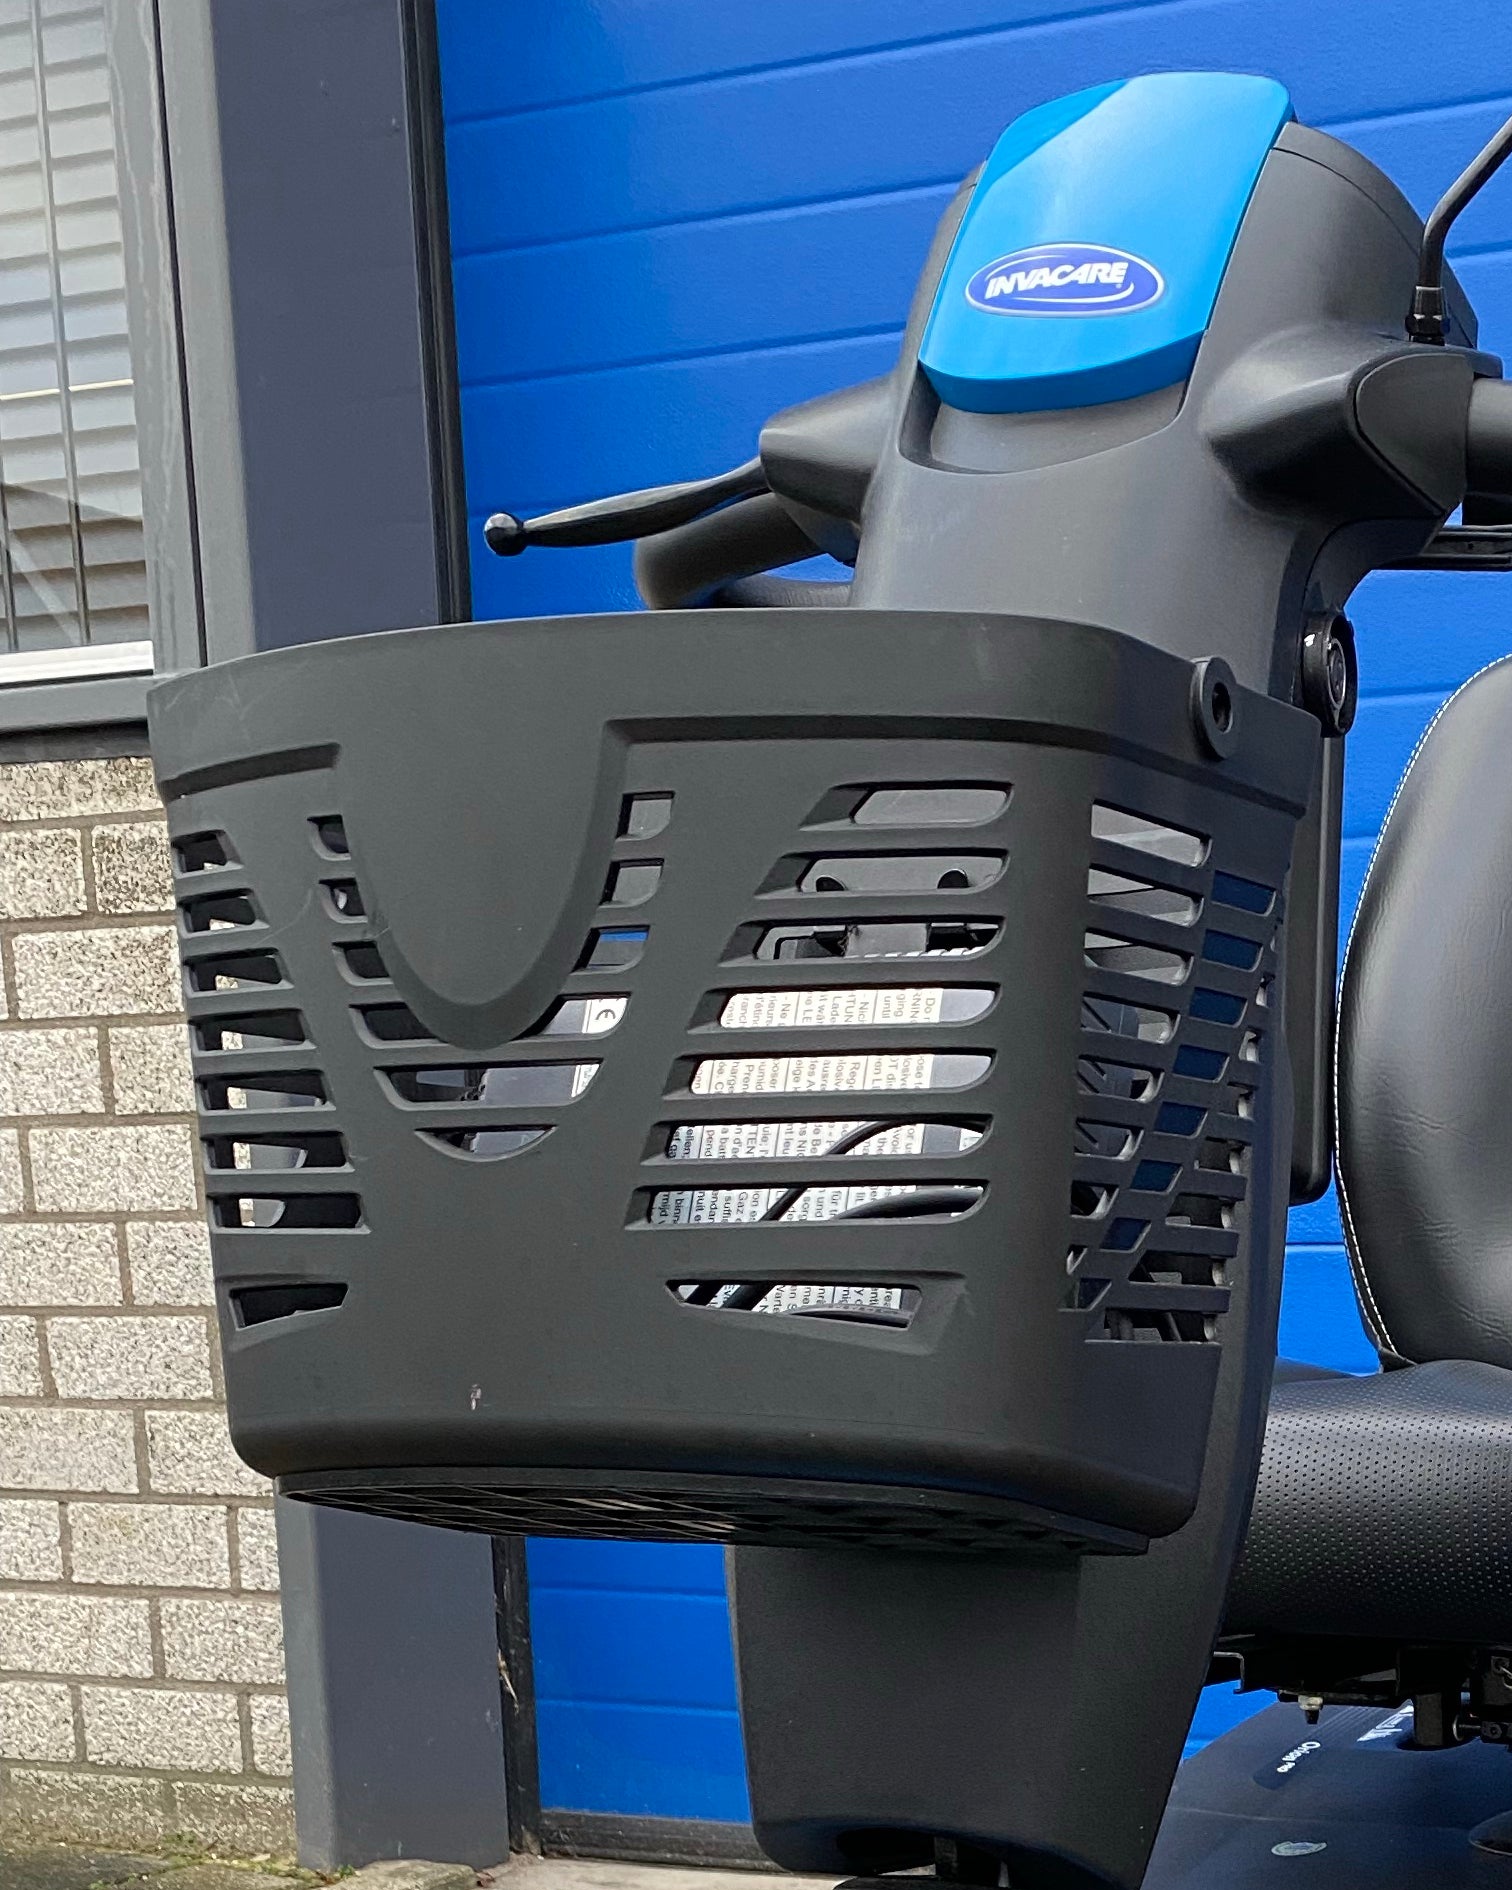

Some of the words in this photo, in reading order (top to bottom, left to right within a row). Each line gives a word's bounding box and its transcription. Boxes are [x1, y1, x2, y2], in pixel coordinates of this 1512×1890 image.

[984, 262, 1128, 299] INVACARE
[894, 994, 907, 1017] ging
[924, 998, 936, 1014] Do
[736, 1191, 749, 1214] Gaz
[815, 1197, 825, 1218] und
